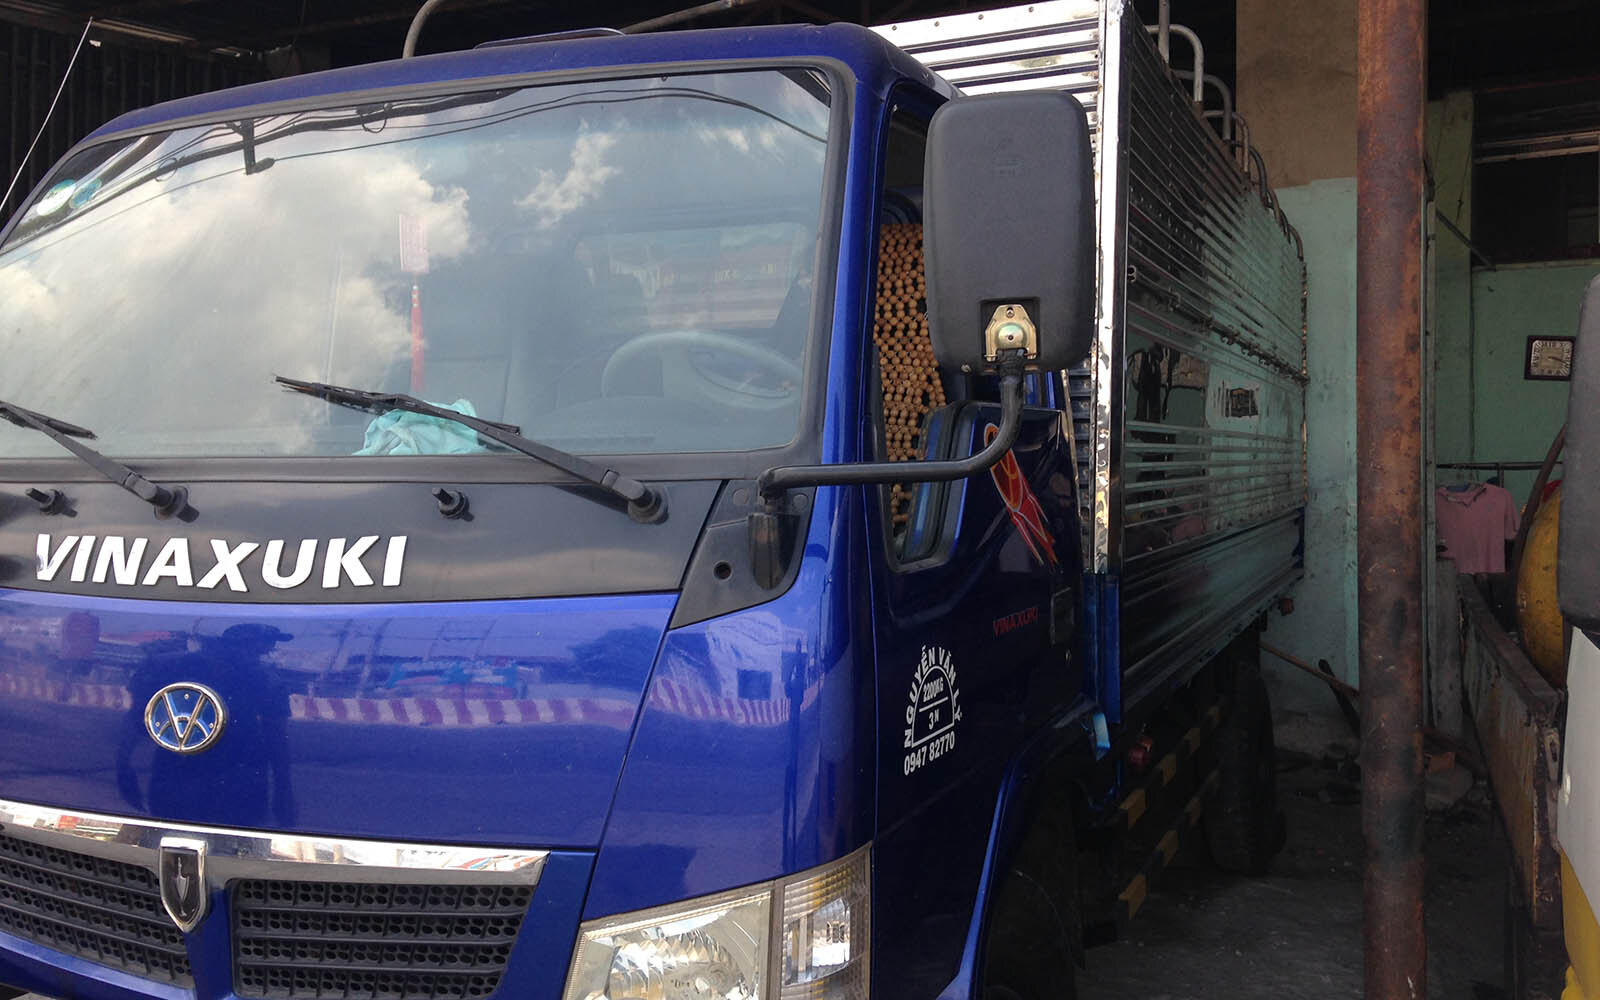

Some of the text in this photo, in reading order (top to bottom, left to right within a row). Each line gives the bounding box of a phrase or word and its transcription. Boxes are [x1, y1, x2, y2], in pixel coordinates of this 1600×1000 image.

[36, 533, 408, 592] VINAXUKI
[904, 730, 956, 776] 0947 82770
